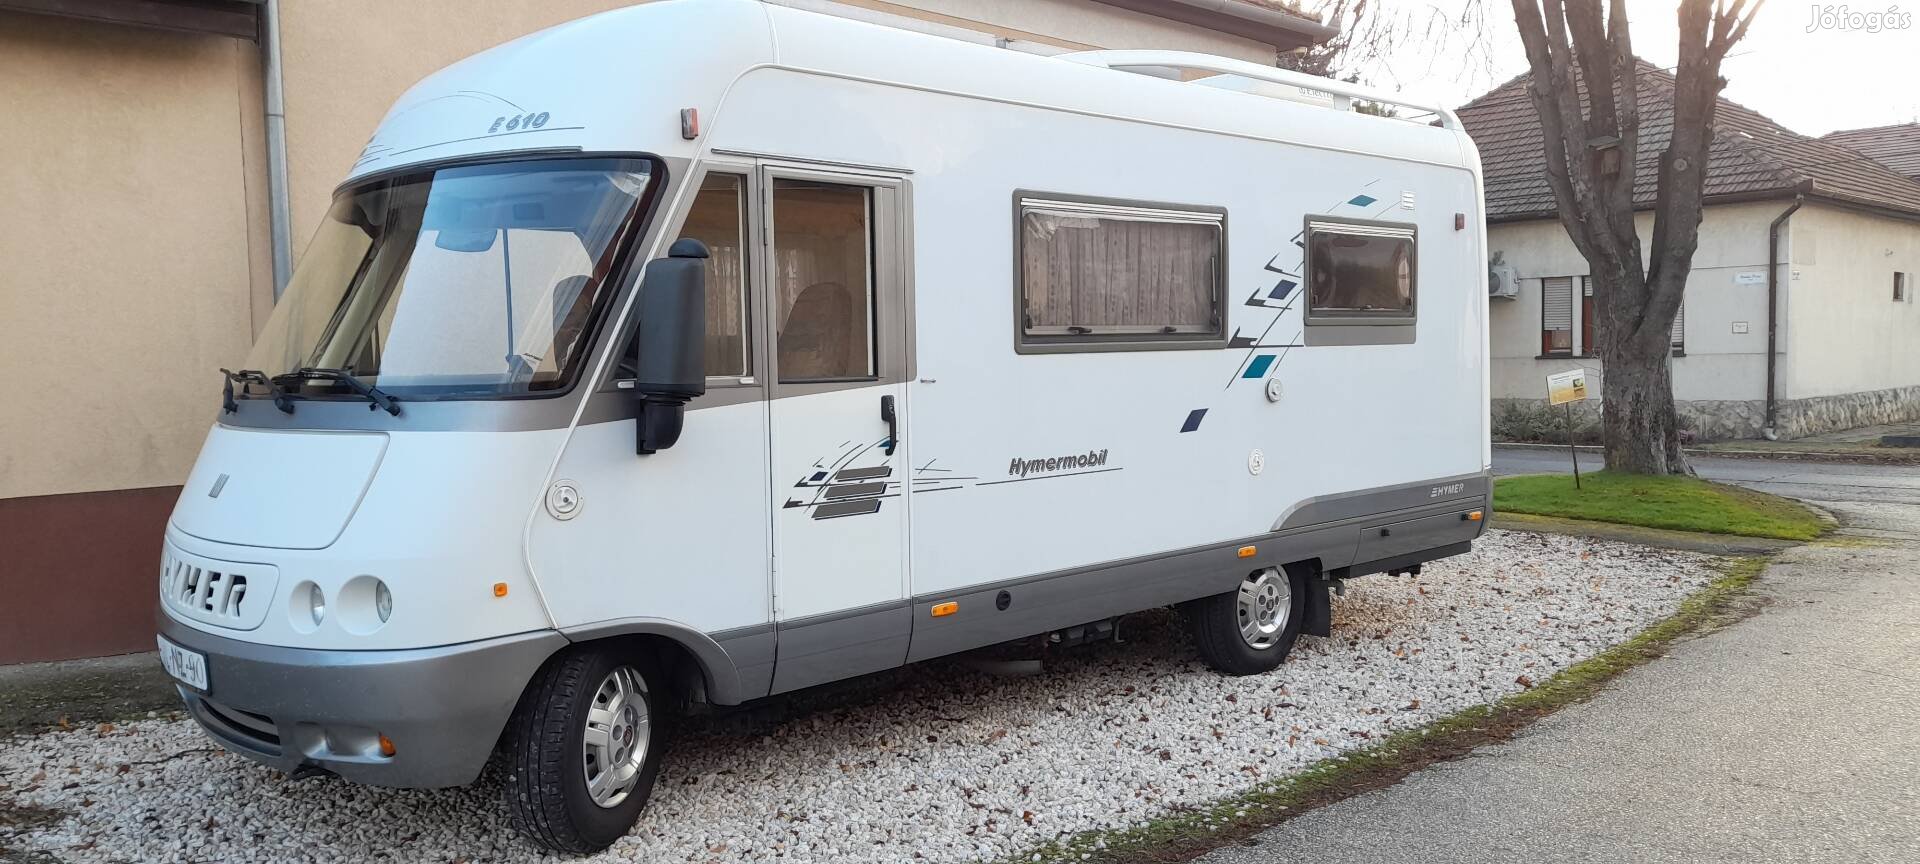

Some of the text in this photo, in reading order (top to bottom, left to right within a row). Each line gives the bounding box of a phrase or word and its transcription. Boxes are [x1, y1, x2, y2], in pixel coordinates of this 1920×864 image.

[488, 111, 550, 133] E 610
[1008, 448, 1108, 478] Hymermobil
